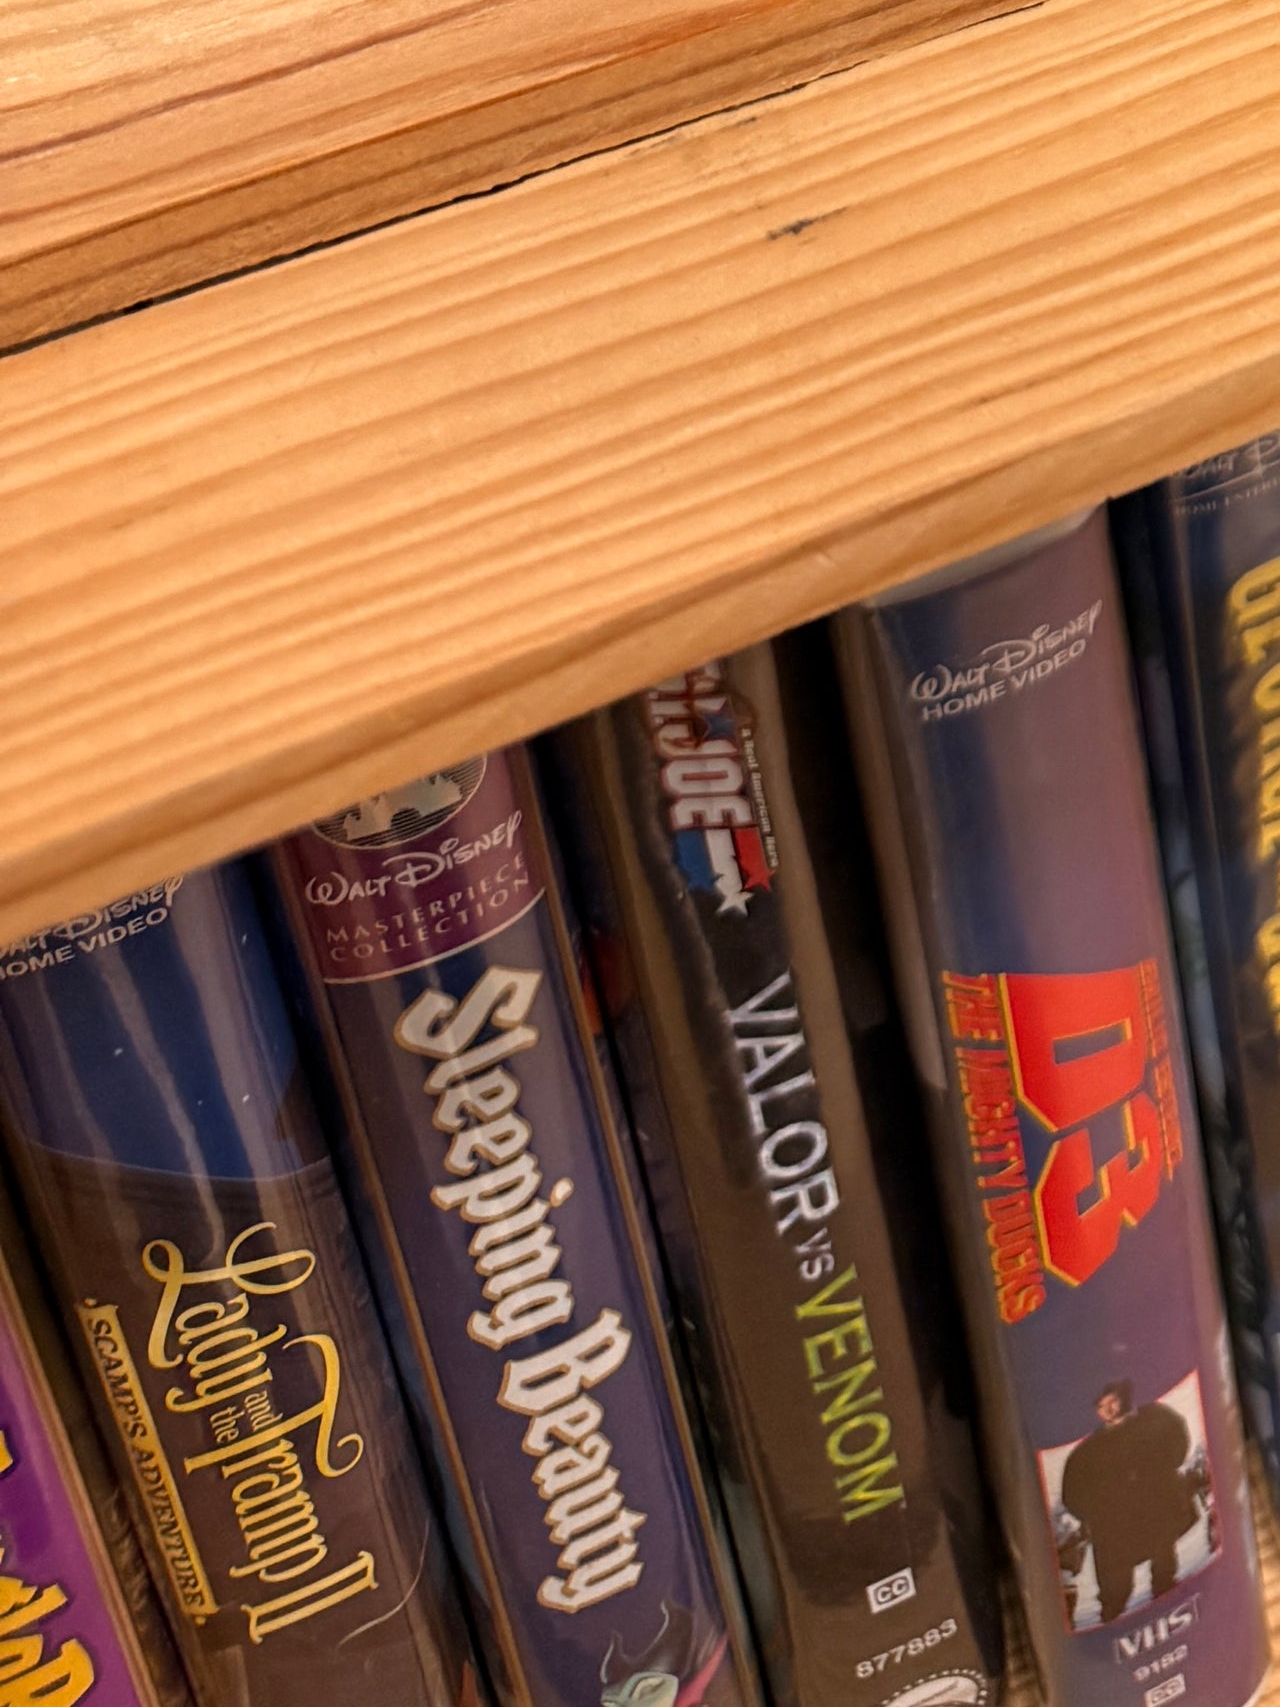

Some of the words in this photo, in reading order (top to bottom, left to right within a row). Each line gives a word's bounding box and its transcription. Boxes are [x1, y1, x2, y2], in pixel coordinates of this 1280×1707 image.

[922, 680, 1006, 721] HOME
[1010, 638, 1087, 688] VIDEO
[76, 906, 169, 955] VIDEO
[326, 850, 526, 944] MASTERPIECE
[330, 871, 529, 962] COLLECTION
[998, 963, 1164, 1288] D3
[393, 965, 575, 1350] Sleeping
[496, 1308, 648, 1615] Beauty
[727, 970, 841, 1237] VALOR
[795, 1262, 906, 1525] VENOM
[981, 1189, 1048, 1325] DUCKS
[142, 1221, 316, 1413] Lady
[86, 1317, 150, 1441] SCAMP'S
[132, 1446, 207, 1608] ADVENTURE
[183, 1333, 365, 1584] Tramp
[209, 1405, 246, 1445] the
[243, 1389, 284, 1432] and
[240, 1549, 379, 1645] II
